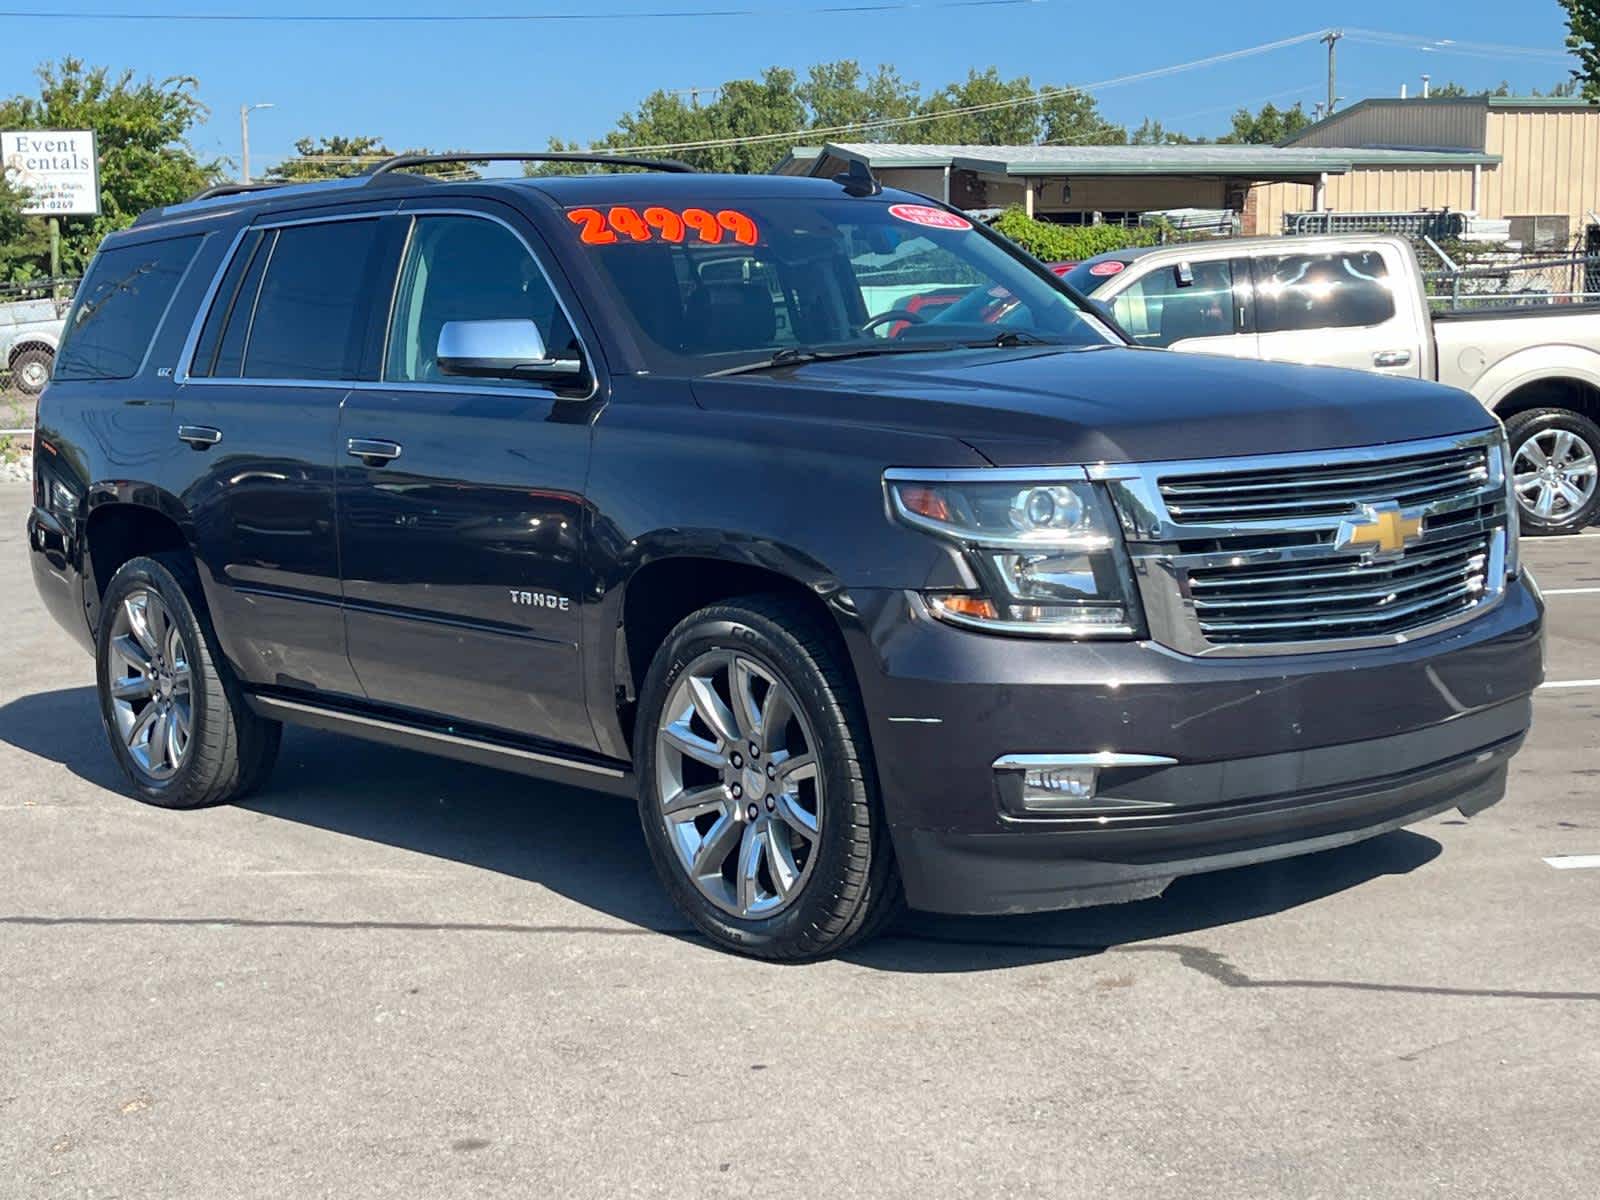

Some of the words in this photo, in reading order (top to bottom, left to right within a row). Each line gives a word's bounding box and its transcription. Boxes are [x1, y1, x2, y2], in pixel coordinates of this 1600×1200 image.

[16, 136, 76, 153] Event
[8, 153, 90, 171] Rentals
[566, 206, 759, 247] 24999
[509, 590, 569, 611] TAHOE
